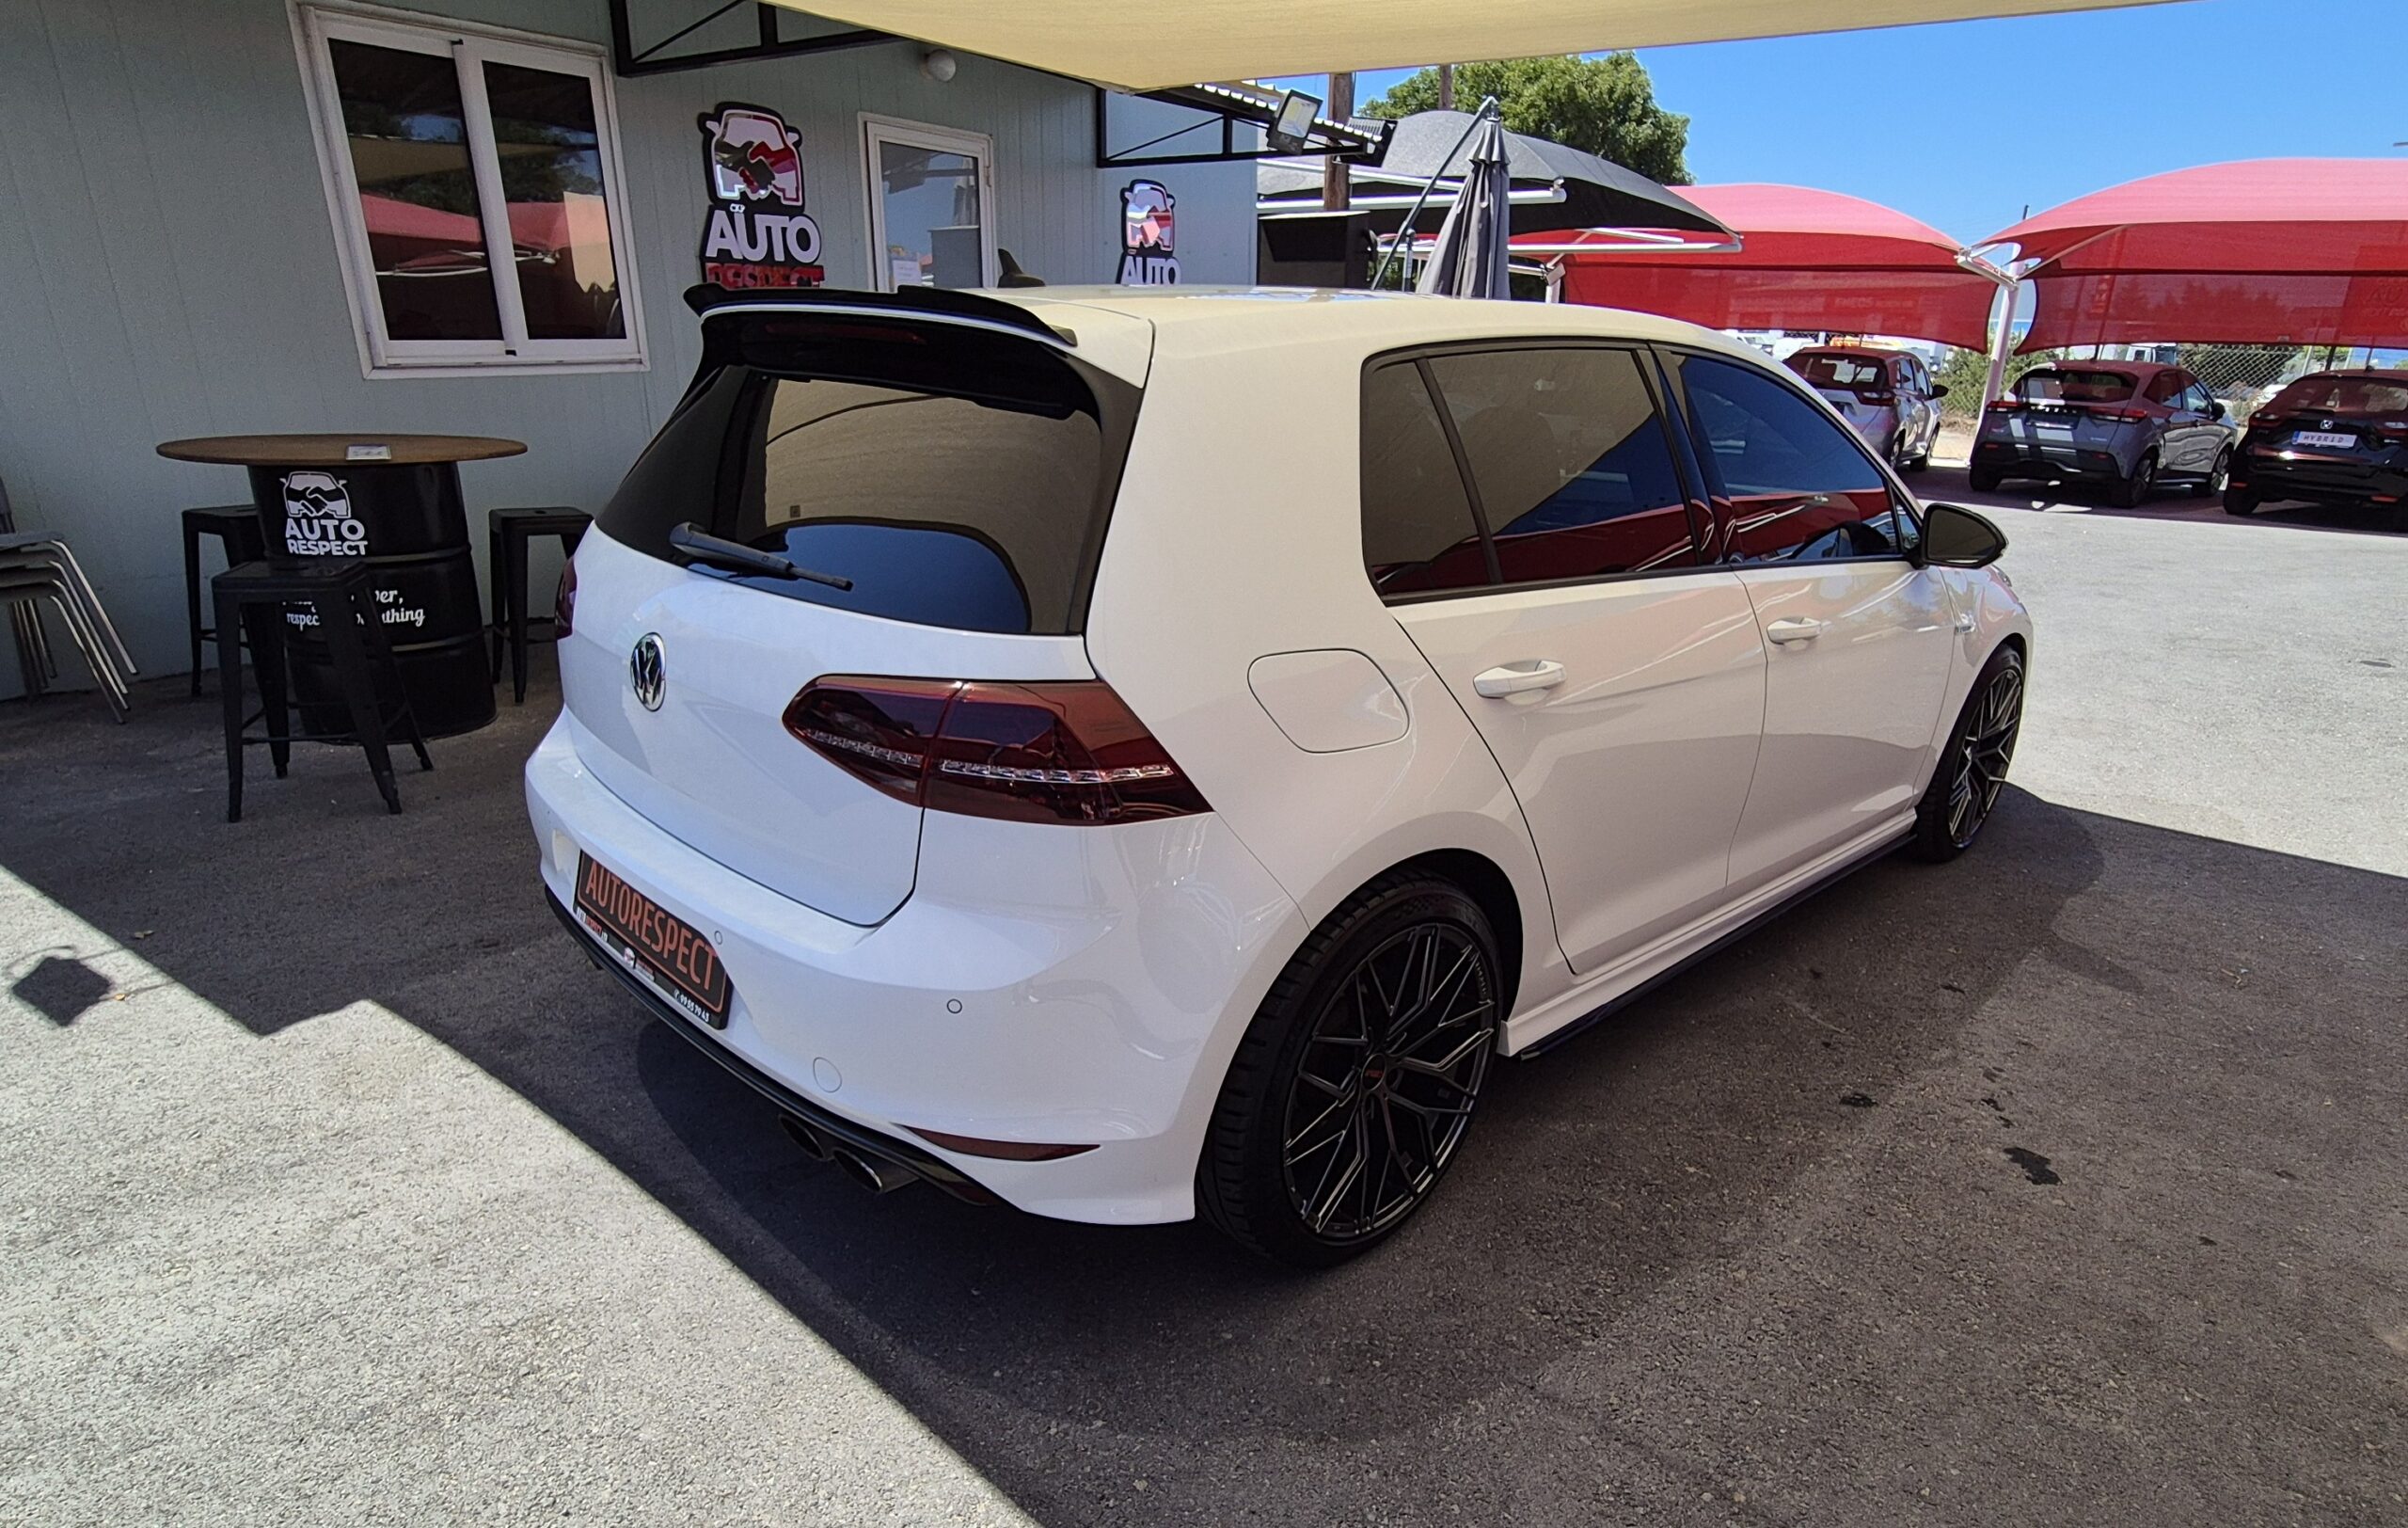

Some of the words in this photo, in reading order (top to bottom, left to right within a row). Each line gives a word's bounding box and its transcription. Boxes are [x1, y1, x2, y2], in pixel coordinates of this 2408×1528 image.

[705, 209, 821, 263] AUTO
[1120, 255, 1181, 286] AUTO
[2303, 435, 2345, 443] HYBRID
[285, 518, 365, 541] AUTO
[286, 539, 368, 555] RESPECT
[585, 859, 717, 991] AUTORESPECT
